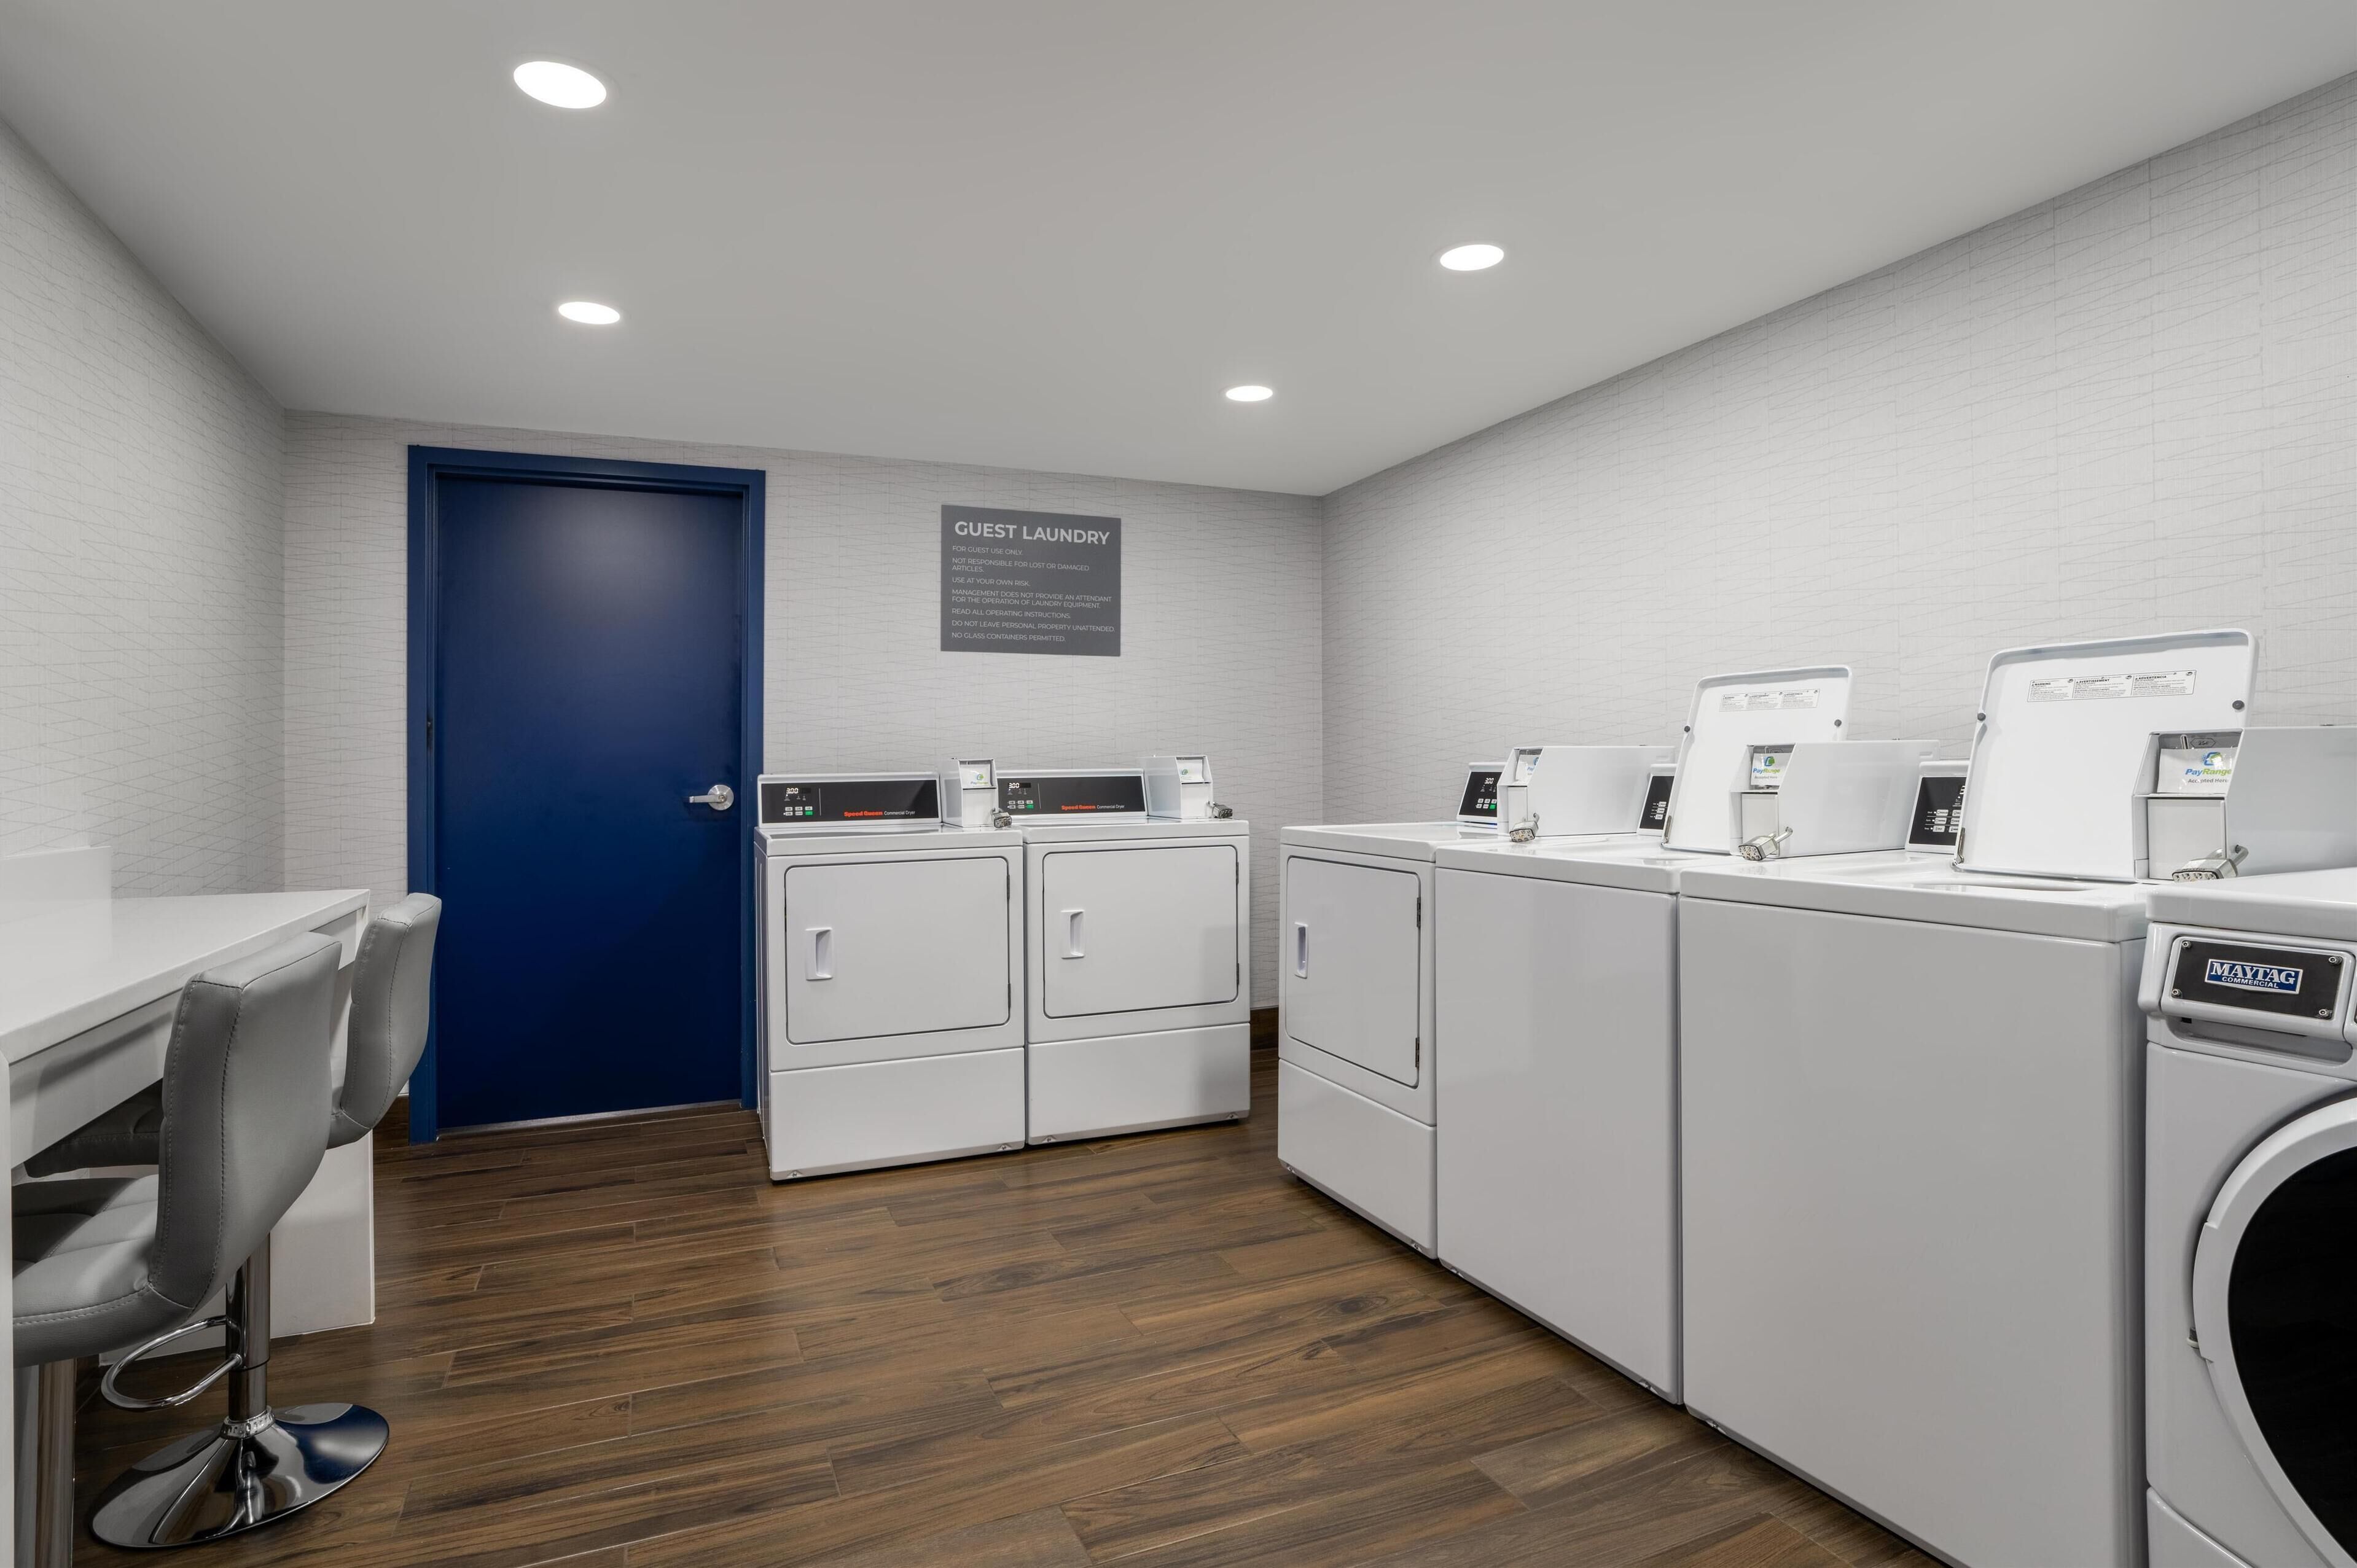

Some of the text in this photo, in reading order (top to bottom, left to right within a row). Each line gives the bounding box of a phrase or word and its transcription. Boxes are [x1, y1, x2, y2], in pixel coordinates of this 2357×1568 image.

[955, 521, 1110, 545] GUEST LAUNDRY
[967, 558, 1012, 567] RESPONSIBLE
[2210, 962, 2296, 985] MAYTAG
[2222, 976, 2279, 989] COMMERCIAL
